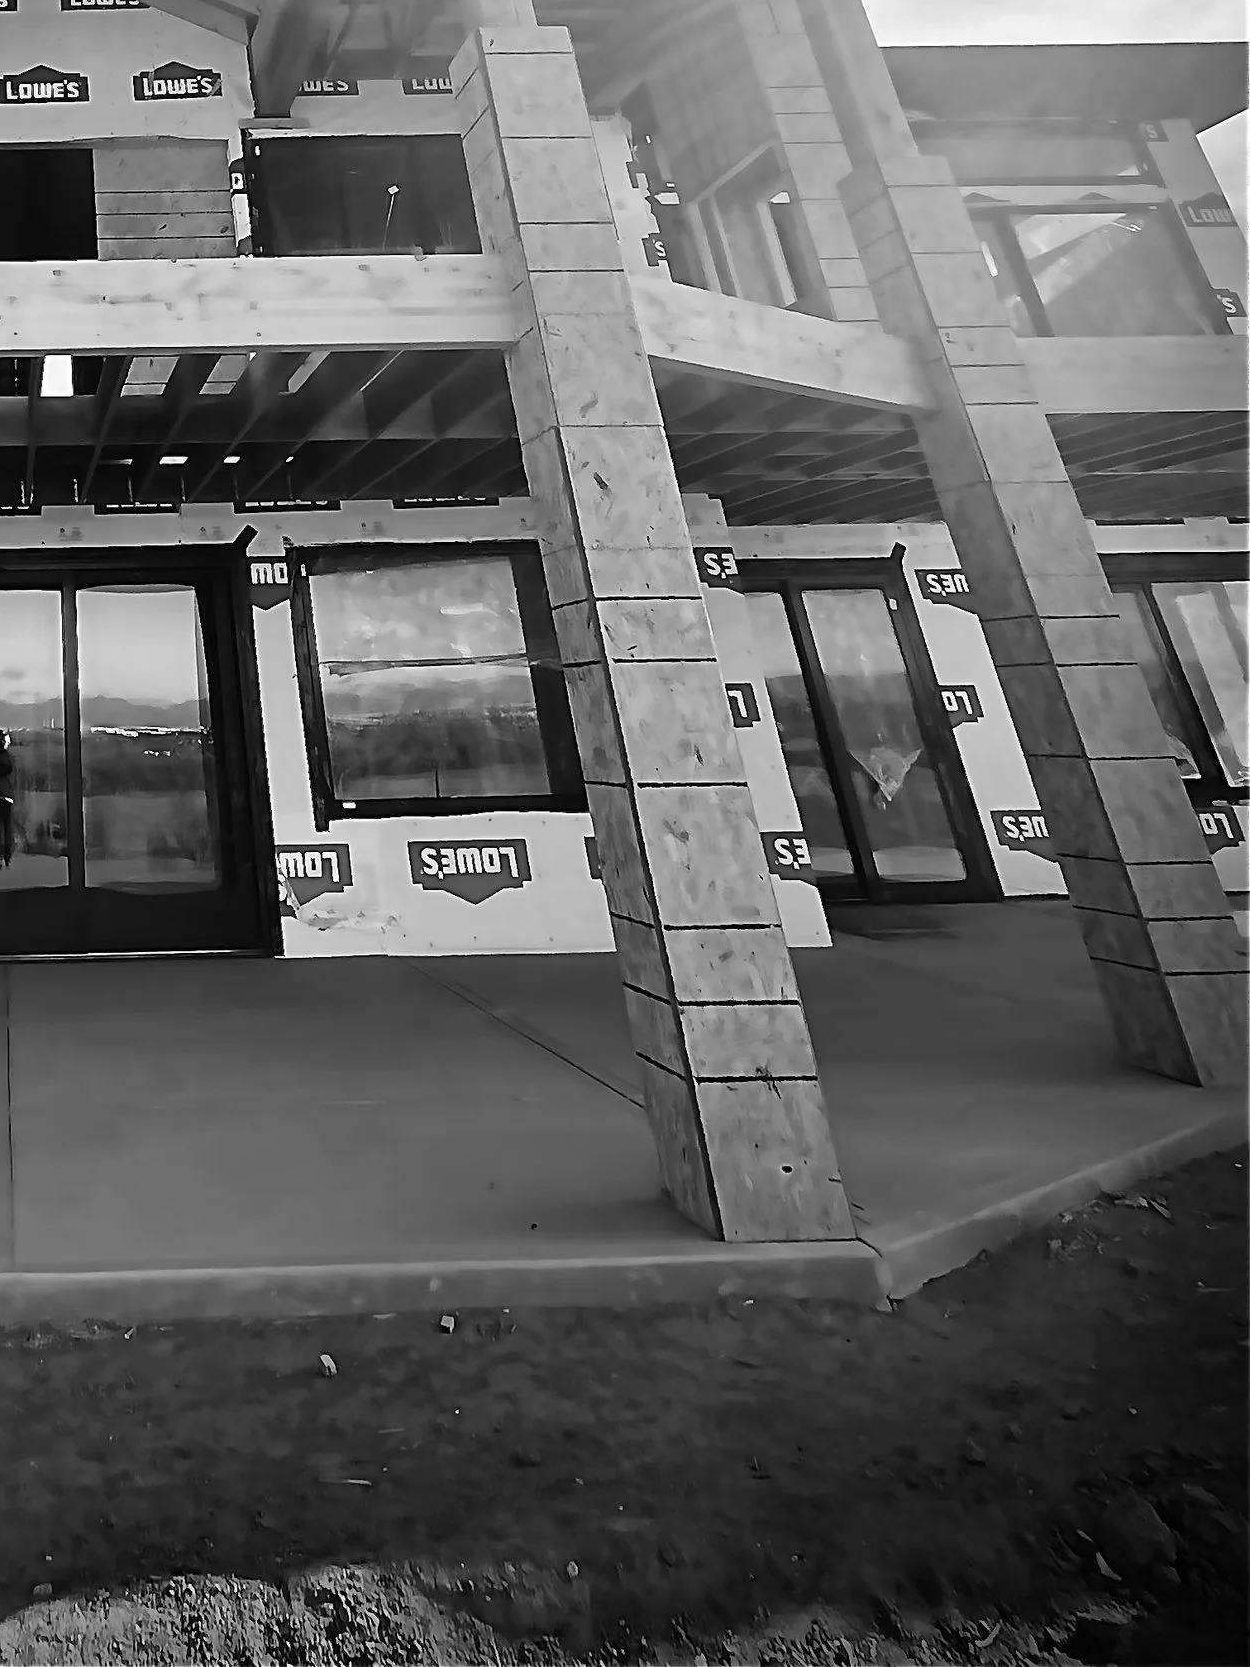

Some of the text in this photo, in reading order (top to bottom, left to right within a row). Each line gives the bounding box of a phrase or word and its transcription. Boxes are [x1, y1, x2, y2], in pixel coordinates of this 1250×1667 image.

[6, 80, 80, 100] LOWE'S
[142, 76, 213, 96] LOWE'S
[1187, 206, 1231, 223] LOW
[278, 851, 340, 883] LOW
[421, 846, 520, 880] LOWE'S
